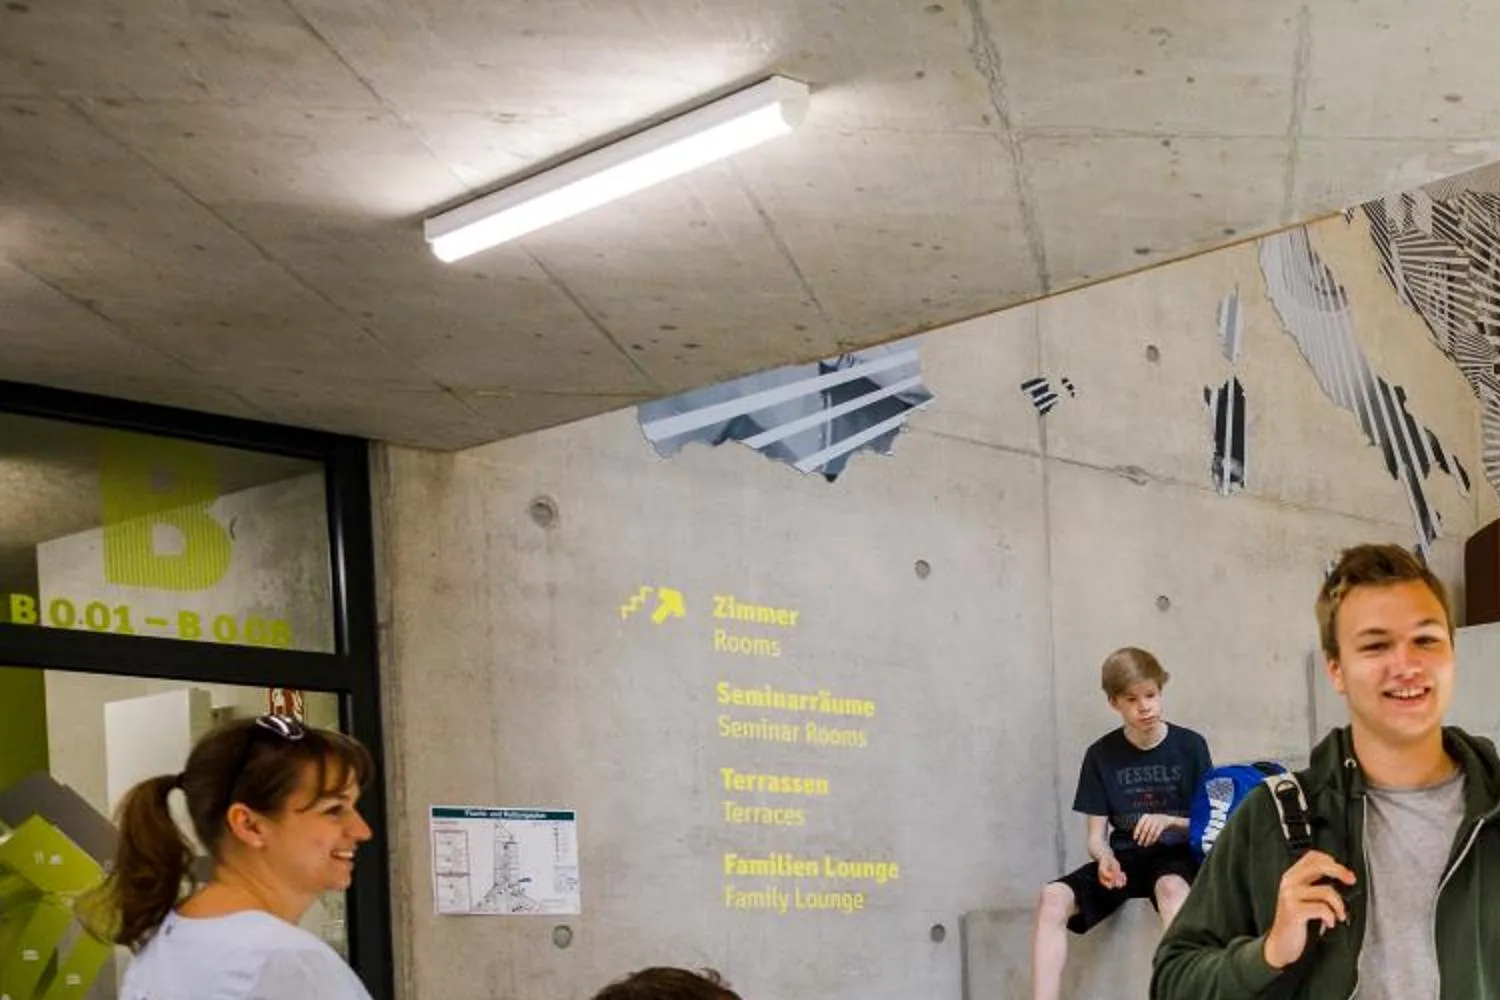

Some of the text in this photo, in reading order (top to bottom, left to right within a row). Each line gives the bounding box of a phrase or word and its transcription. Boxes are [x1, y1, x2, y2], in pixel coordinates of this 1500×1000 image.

[101, 434, 233, 592] B
[10, 594, 37, 625] B
[177, 609, 203, 640] B
[713, 595, 799, 625] Zimmer
[713, 628, 782, 657] Rooms
[716, 681, 876, 717] Seminarräume
[718, 715, 868, 748] Seminar Rooms
[720, 767, 829, 795] Terrassen
[722, 799, 805, 826] Terraces
[723, 853, 899, 884] Familien Lounge
[725, 885, 865, 914] Family Lounge
